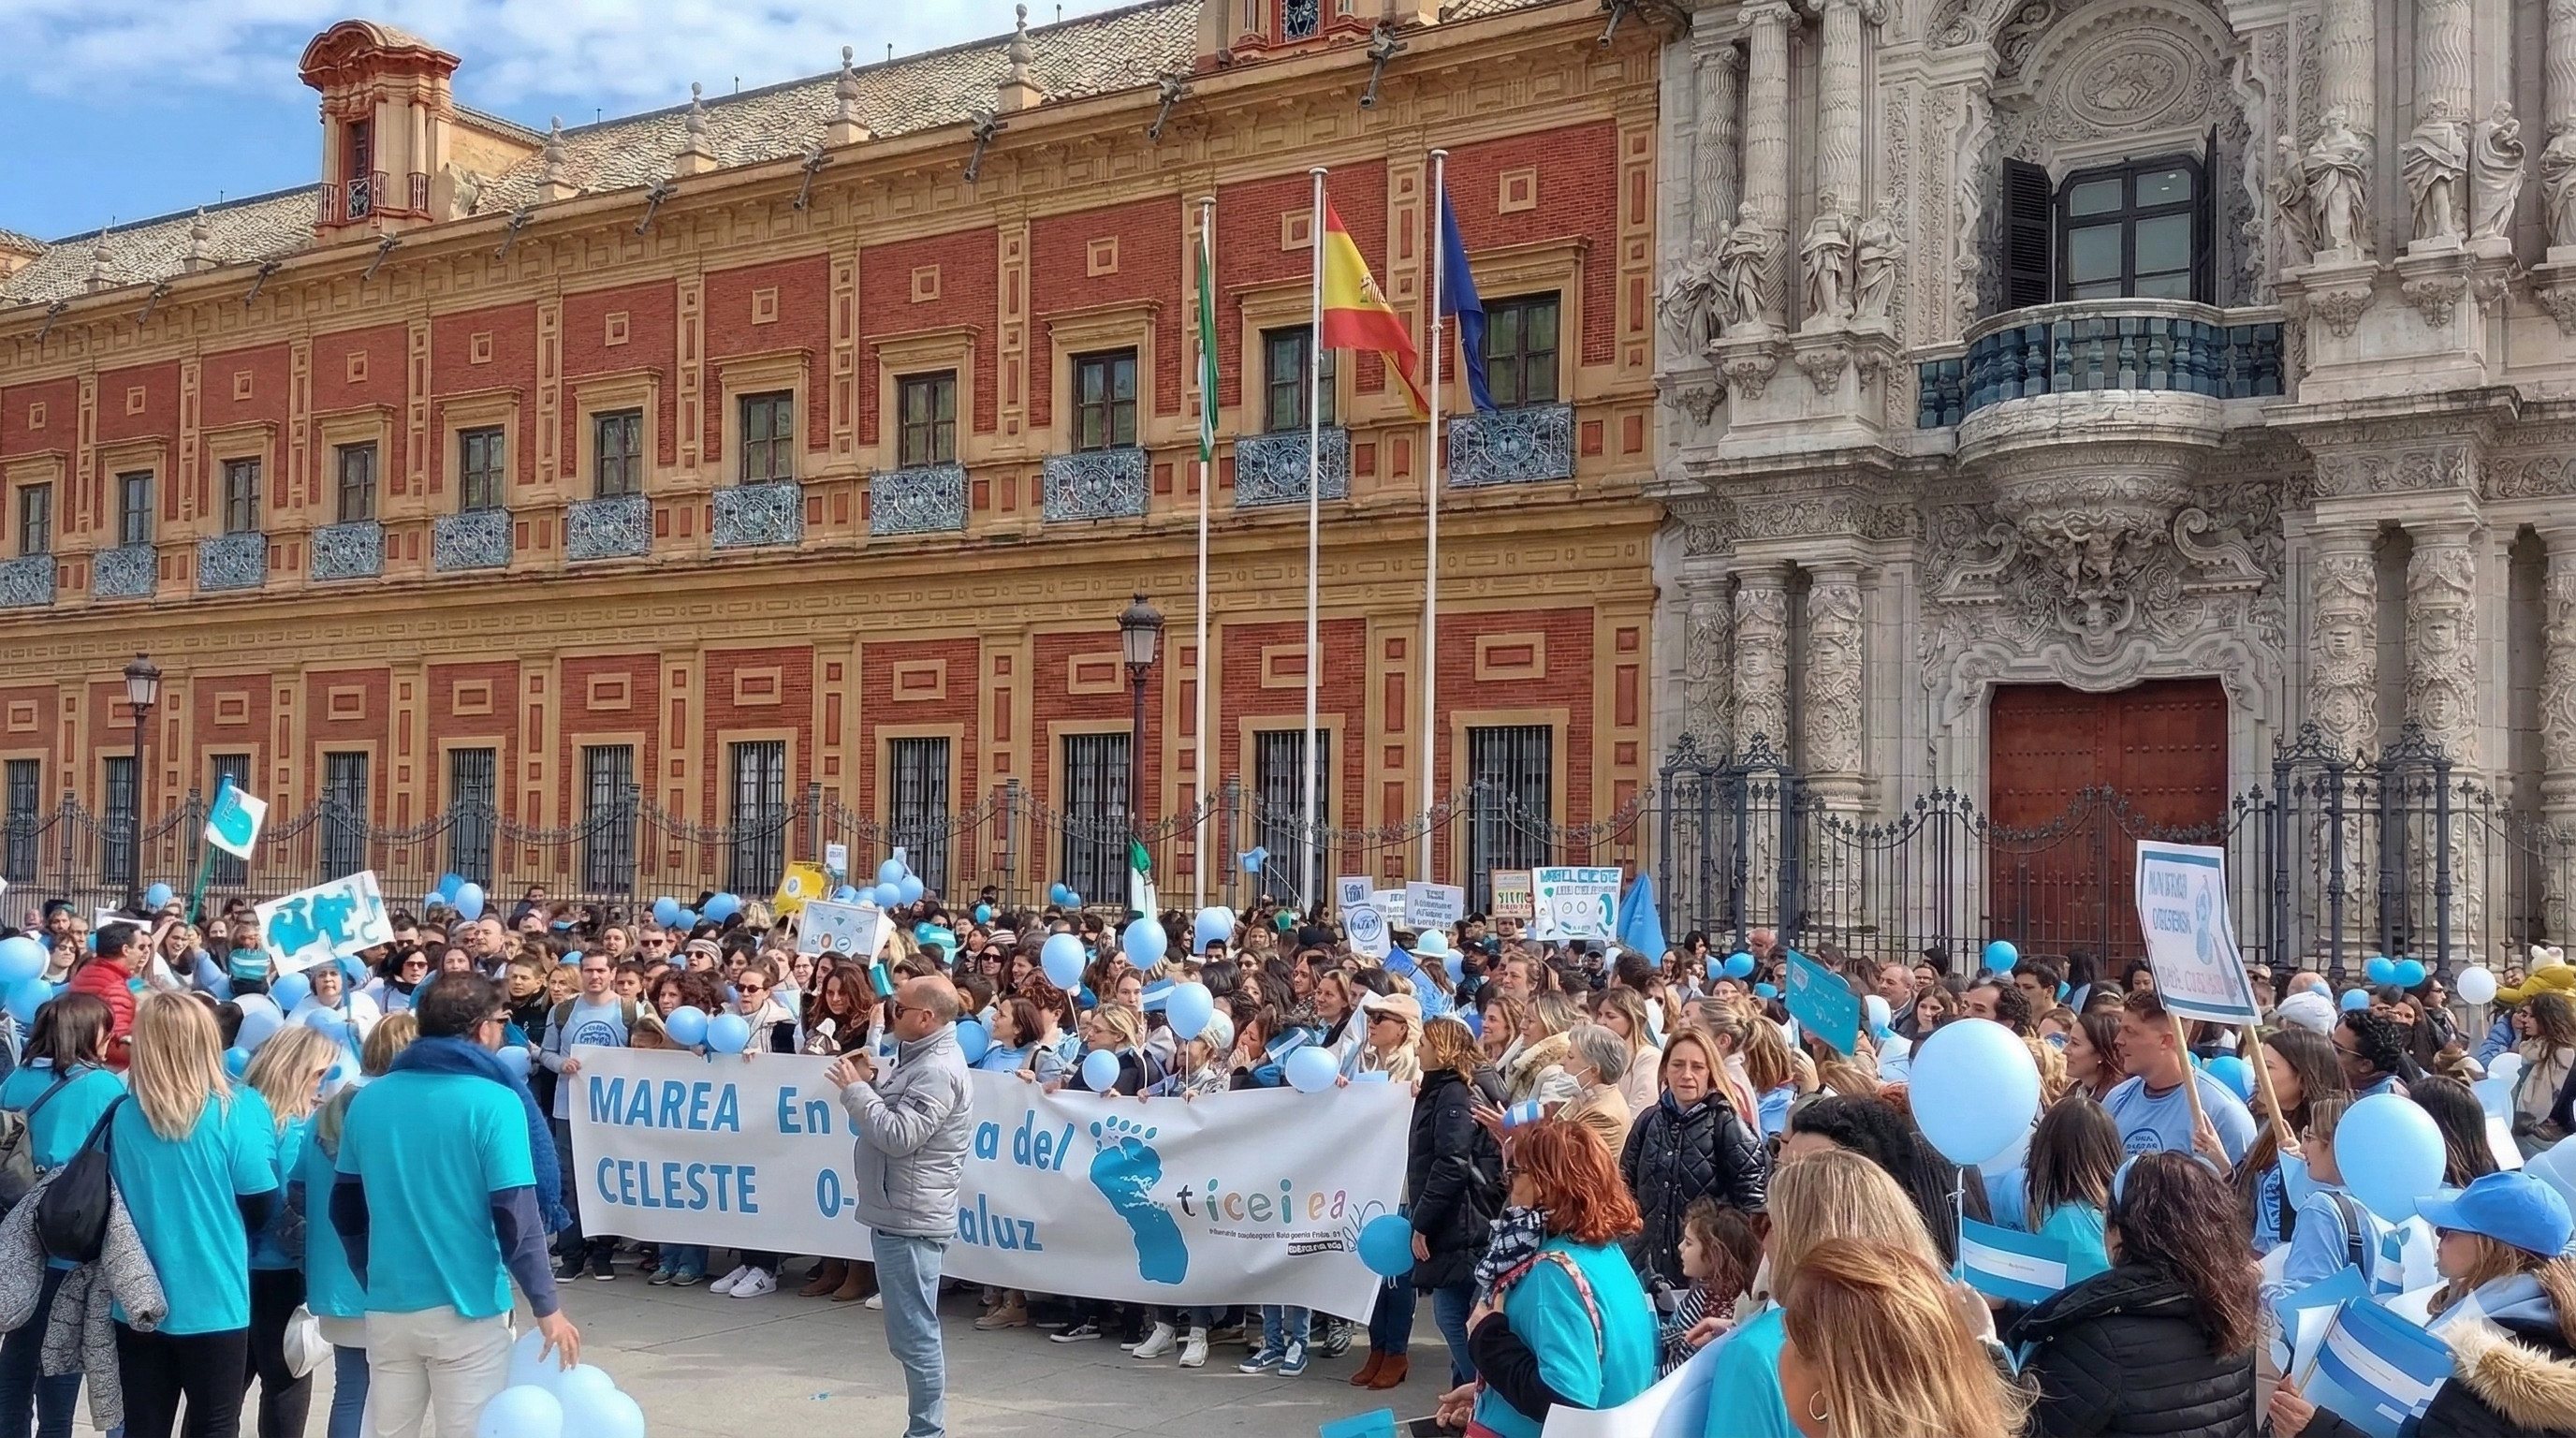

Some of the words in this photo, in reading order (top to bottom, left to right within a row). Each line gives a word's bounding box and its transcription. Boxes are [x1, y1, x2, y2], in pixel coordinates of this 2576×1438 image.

[590, 1077, 740, 1132] MAREA
[778, 1087, 830, 1135] En
[1013, 1110, 1076, 1171] del
[596, 1157, 759, 1213] CELESTE
[816, 1168, 856, 1218] 0-
[955, 1194, 1045, 1252] aluz
